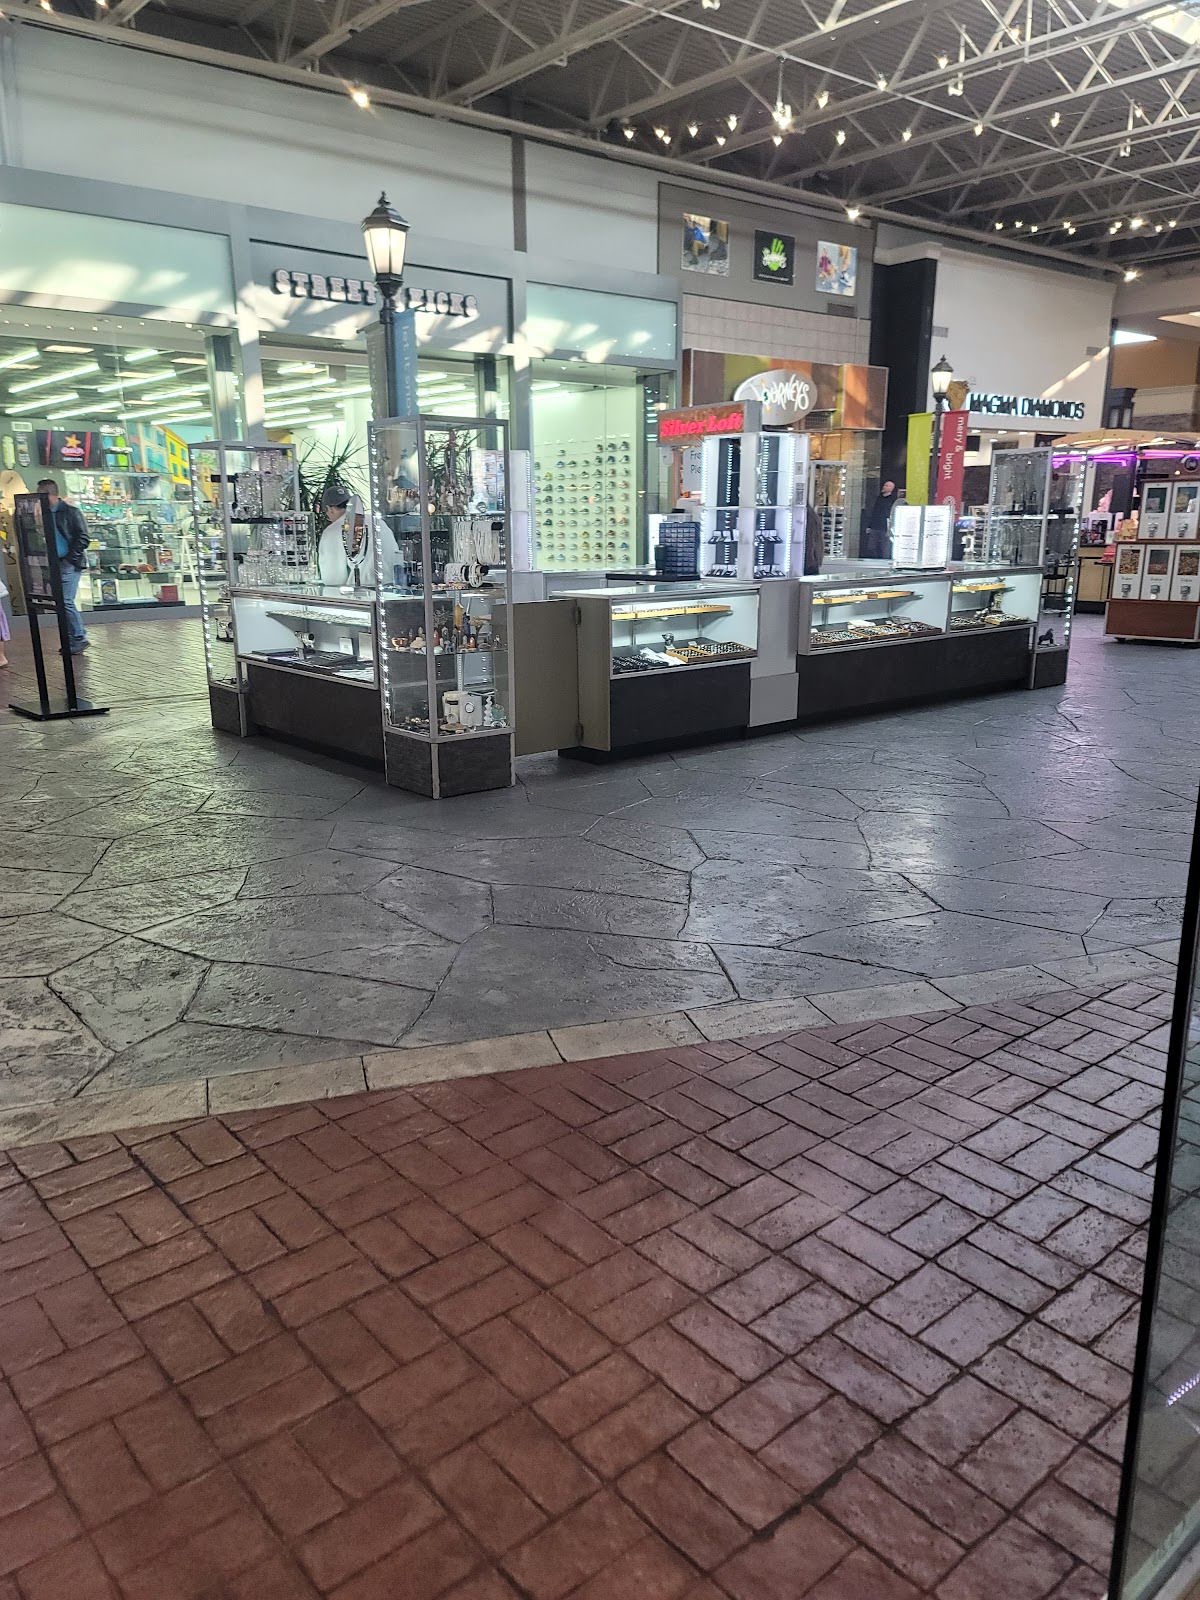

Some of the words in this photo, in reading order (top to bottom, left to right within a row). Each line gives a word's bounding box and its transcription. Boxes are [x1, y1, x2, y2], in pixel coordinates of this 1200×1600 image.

[273, 269, 379, 305] STREET
[407, 287, 479, 317] KICKS
[969, 393, 1019, 416] MAGMA
[1021, 398, 1085, 419] DIAMONDS
[661, 417, 704, 437] Silver
[706, 412, 743, 433] Loft
[954, 416, 965, 443] merry
[954, 445, 964, 453] &
[943, 452, 954, 480] bright
